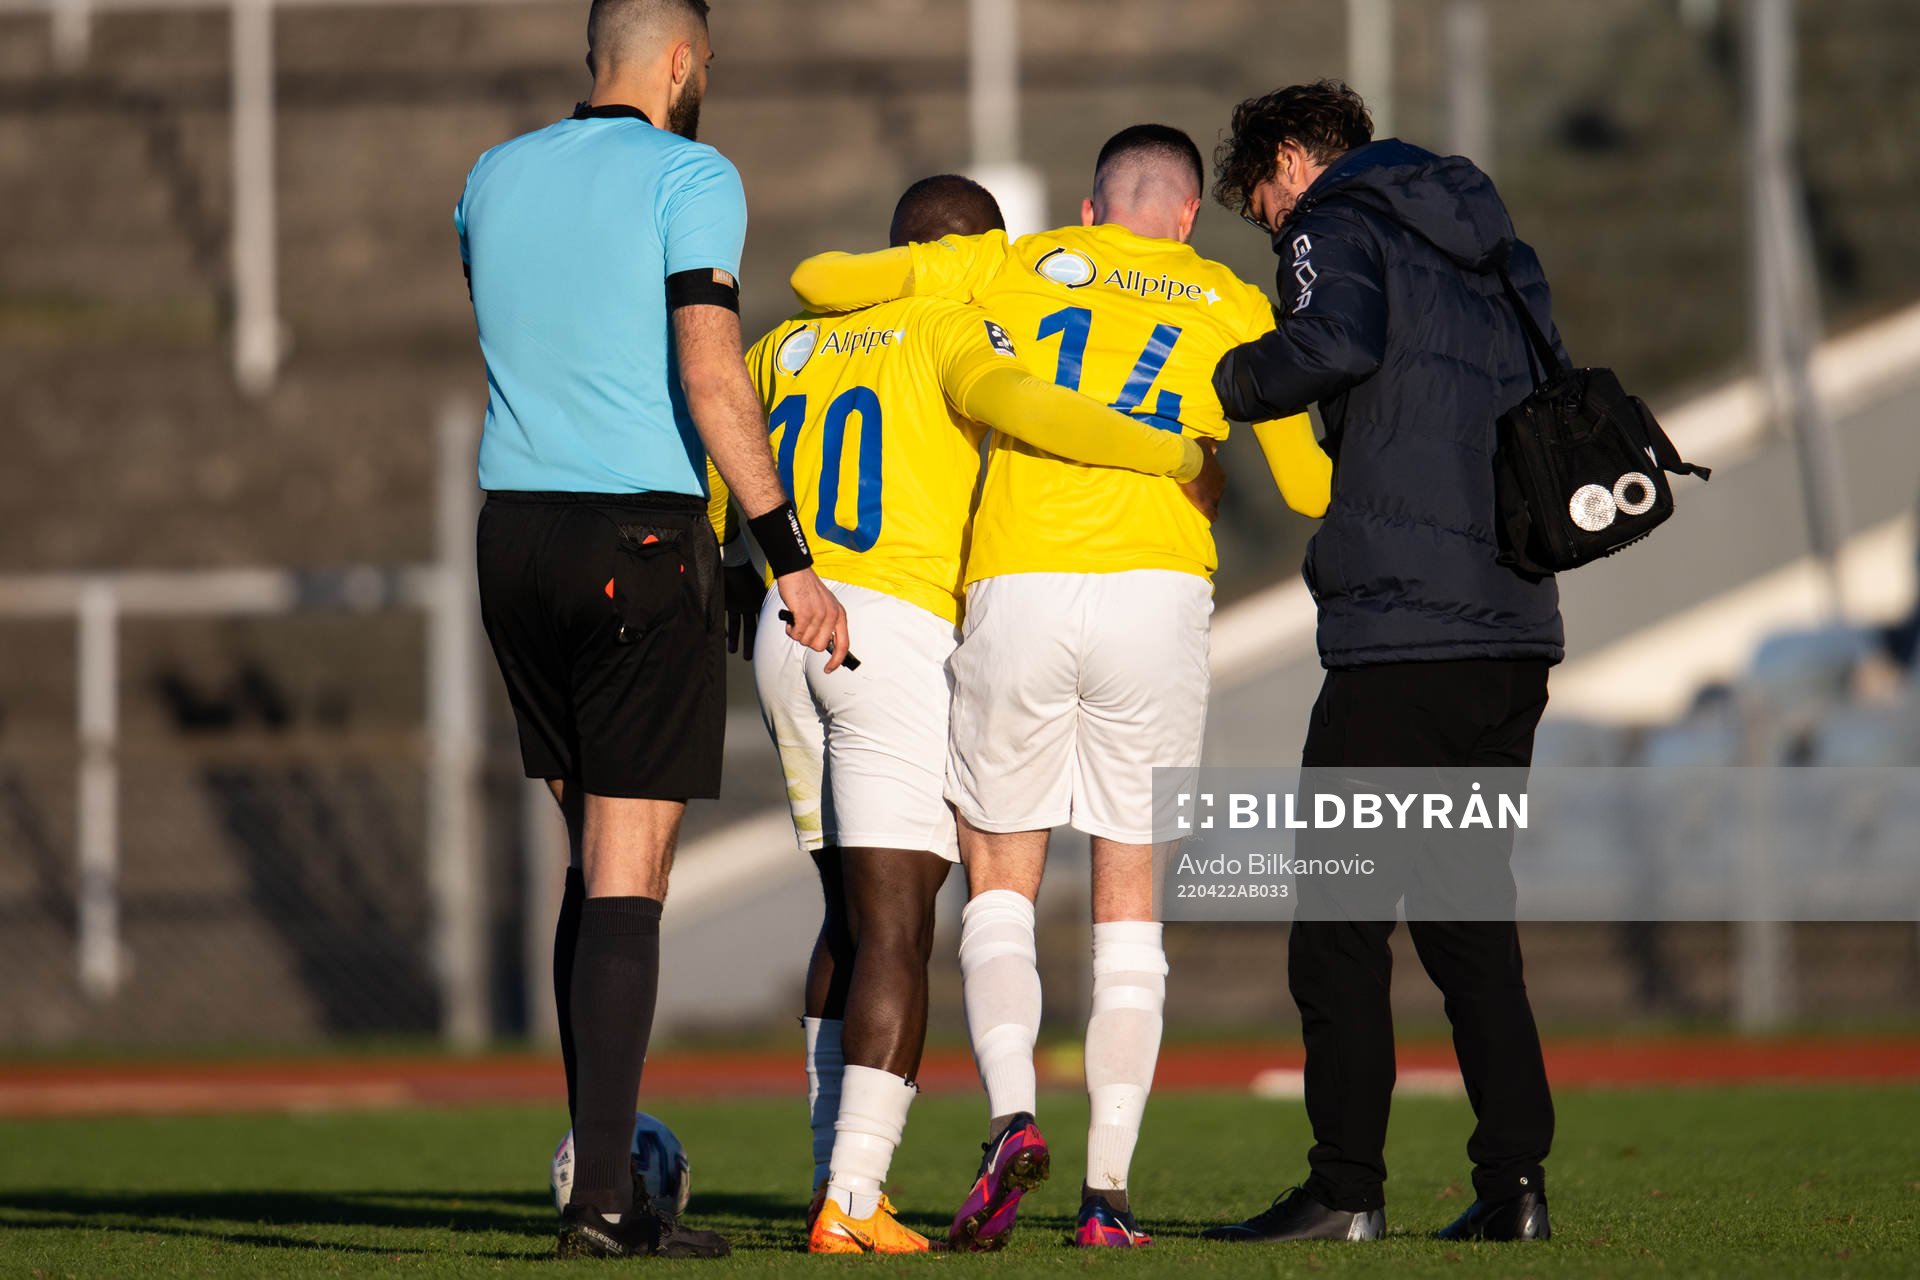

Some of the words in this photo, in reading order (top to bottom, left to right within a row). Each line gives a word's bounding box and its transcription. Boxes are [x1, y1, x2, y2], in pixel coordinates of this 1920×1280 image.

[1103, 268, 1202, 301] Allpipe
[820, 326, 895, 358] Allpipe
[1036, 306, 1183, 434] 14
[769, 386, 882, 553] 10
